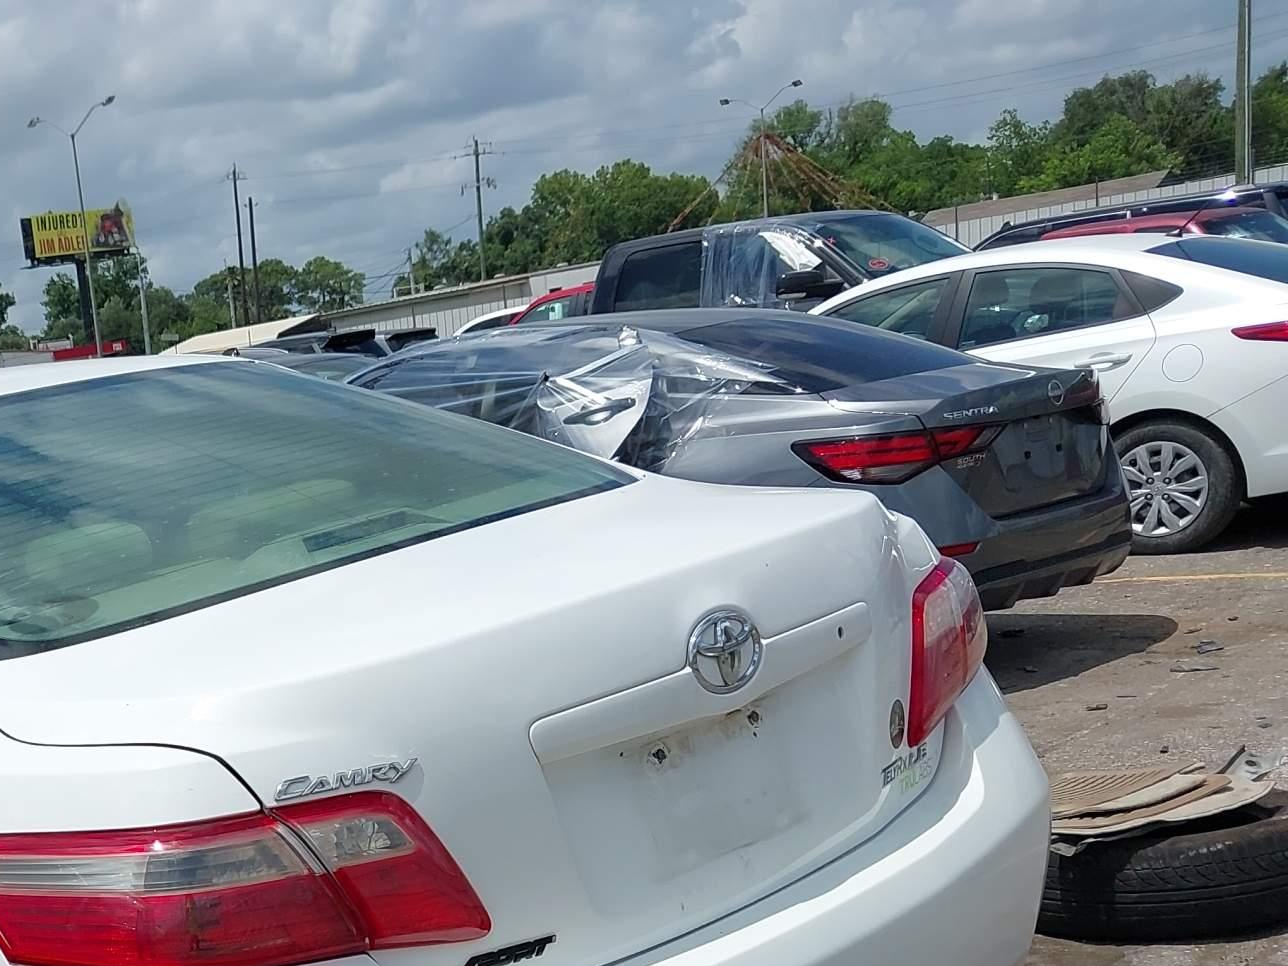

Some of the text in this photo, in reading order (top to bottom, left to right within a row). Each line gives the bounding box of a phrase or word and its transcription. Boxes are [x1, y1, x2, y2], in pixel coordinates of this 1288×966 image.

[39, 237, 56, 255] JIM
[943, 405, 999, 419] SENTRA
[274, 757, 418, 801] CAMRY
